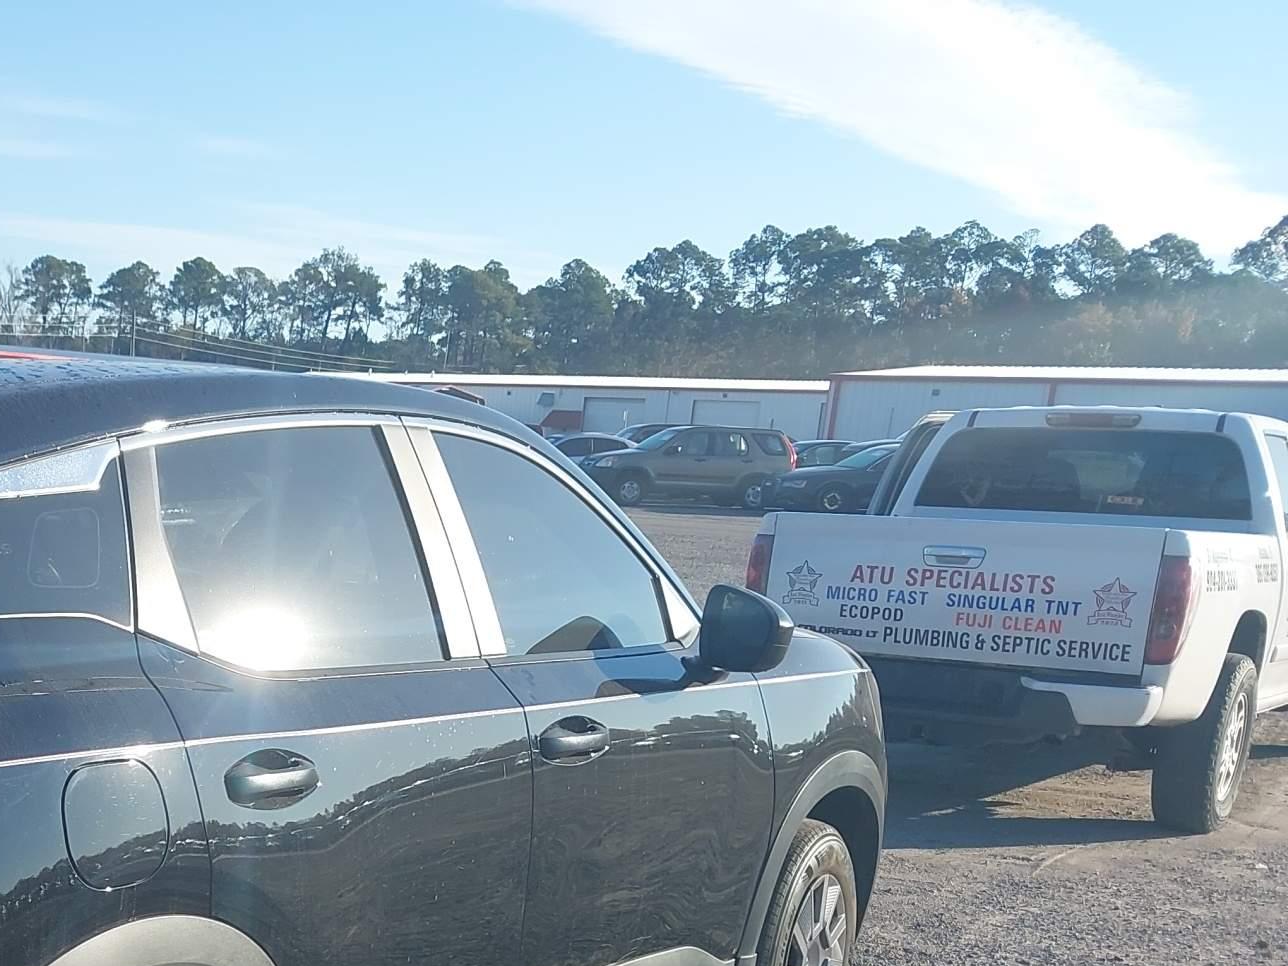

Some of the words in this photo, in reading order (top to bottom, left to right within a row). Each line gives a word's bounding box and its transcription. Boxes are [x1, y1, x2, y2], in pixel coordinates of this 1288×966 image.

[850, 564, 895, 585] ATU
[905, 567, 1057, 596] SPECIALISTS
[826, 585, 879, 602] MICRO
[887, 589, 929, 606] FAST
[945, 592, 1036, 613] SINGULAR
[1045, 599, 1082, 616] TNT
[839, 603, 904, 622] ECOPOD
[955, 612, 993, 630] FUJI
[1002, 615, 1063, 634] CLEAN
[866, 630, 880, 639] LT
[882, 626, 970, 650] PLUMBING
[974, 633, 986, 651] &
[990, 634, 1051, 656] SEPTIC
[1056, 639, 1132, 663] SERVICE
